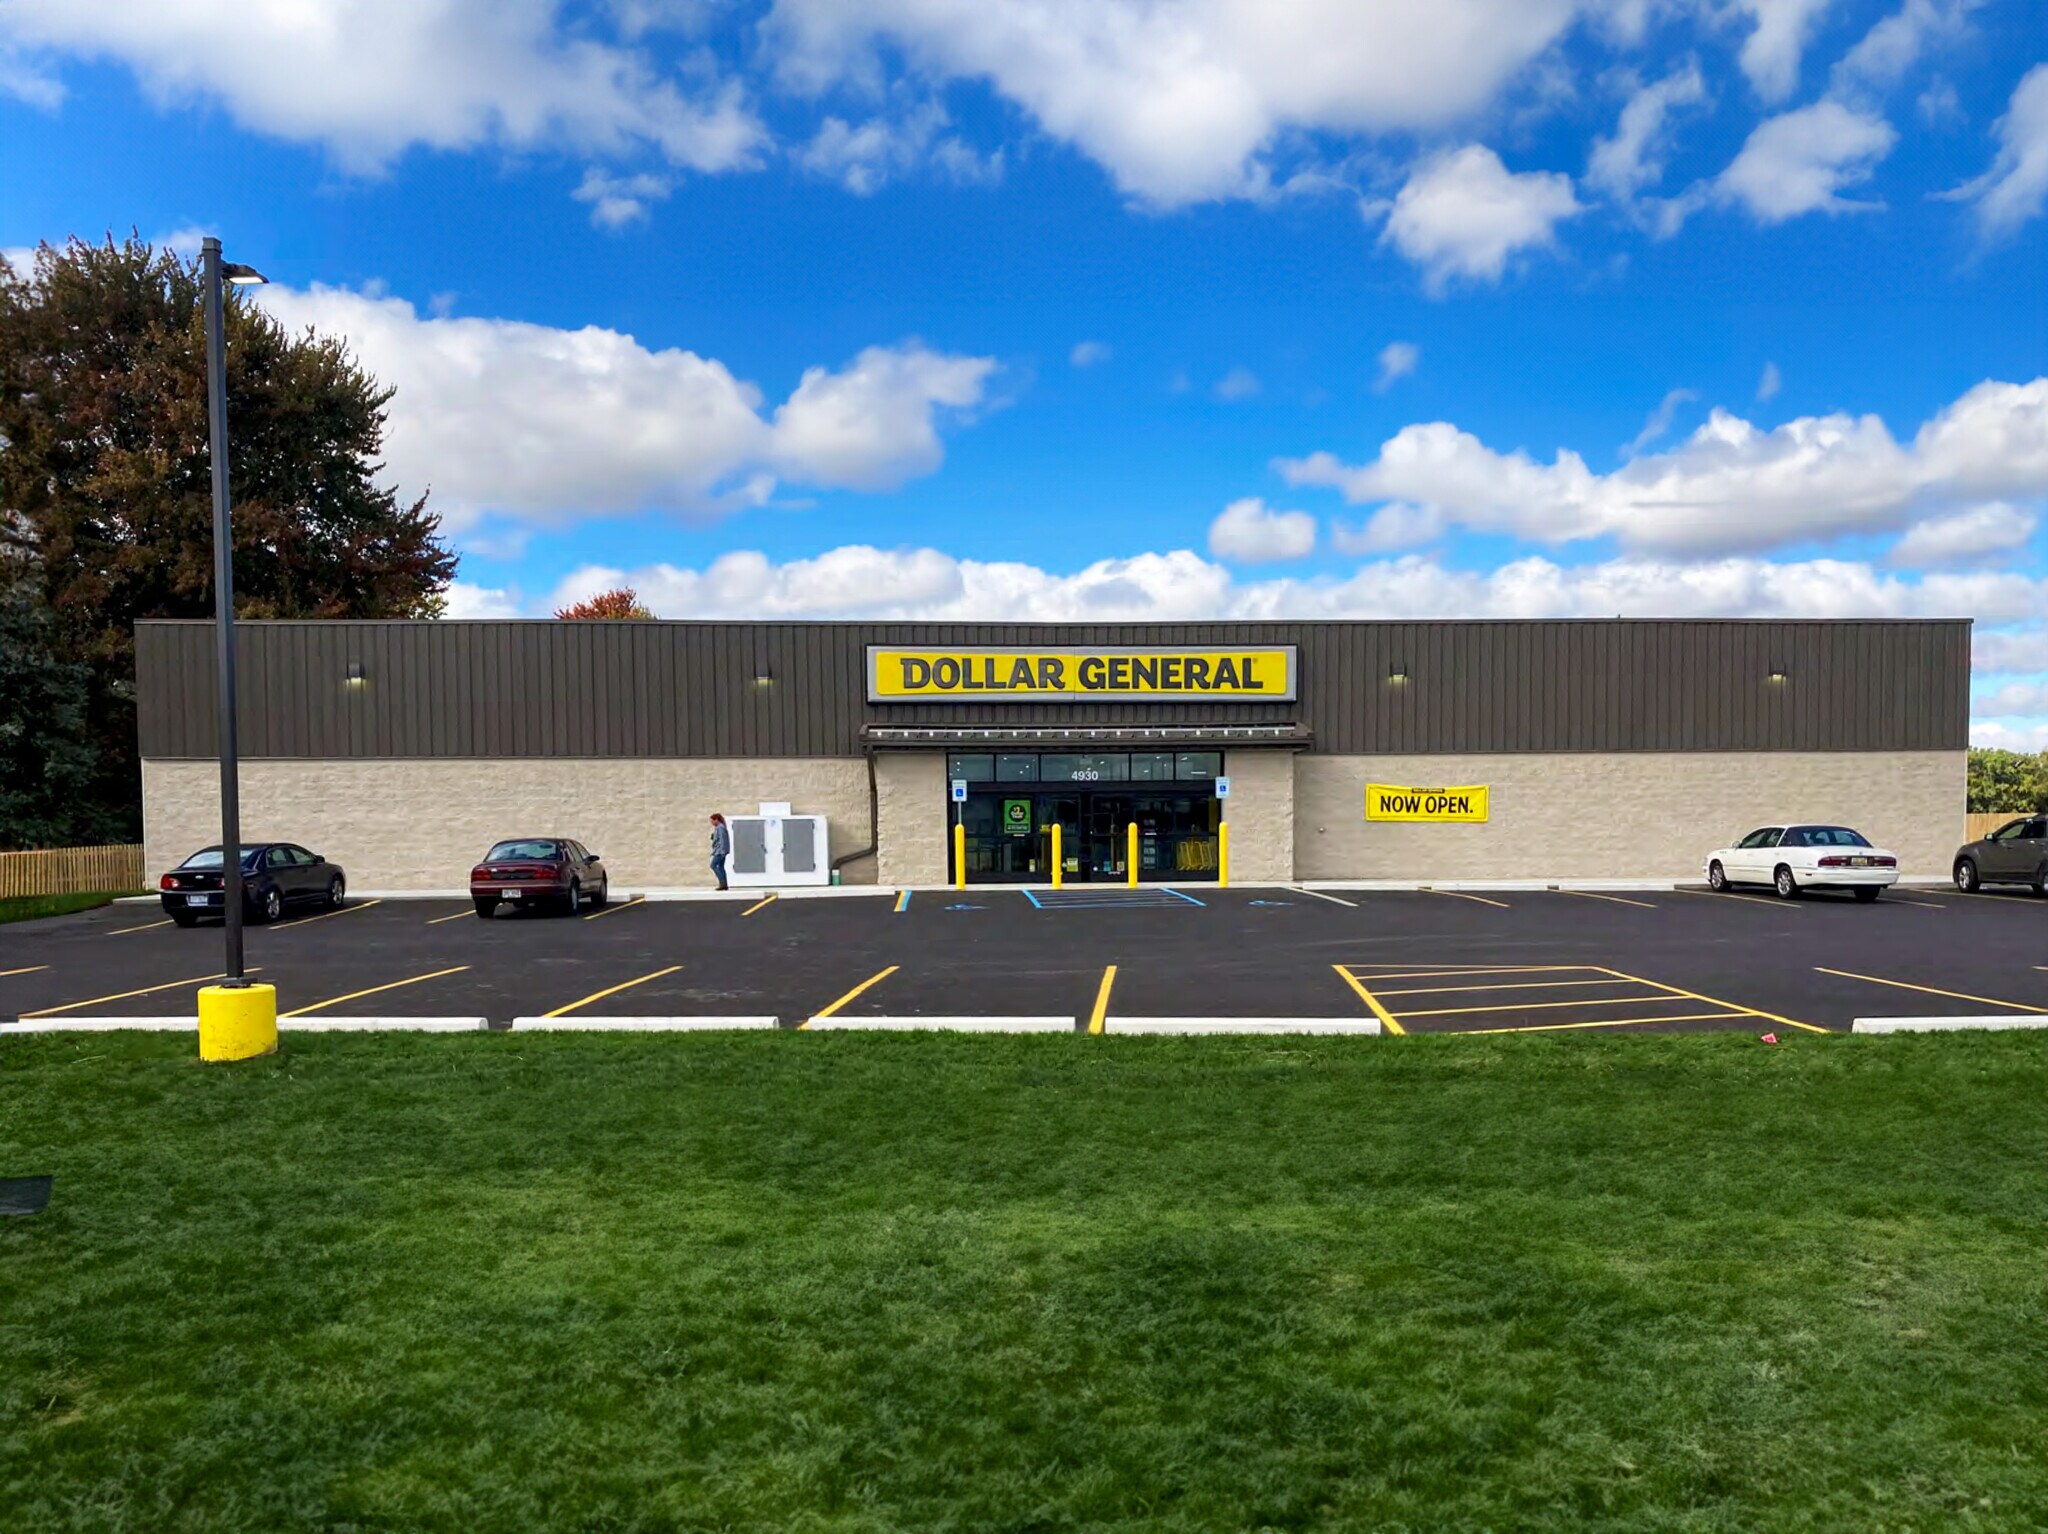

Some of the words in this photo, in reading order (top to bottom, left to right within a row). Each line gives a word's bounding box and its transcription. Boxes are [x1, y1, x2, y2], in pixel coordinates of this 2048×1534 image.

[900, 657, 1065, 690] DOLLAR
[1078, 657, 1263, 689] GENERAL
[1071, 770, 1099, 781] 4930
[1380, 795, 1421, 813] NOW
[1425, 795, 1473, 814] OPEN.
